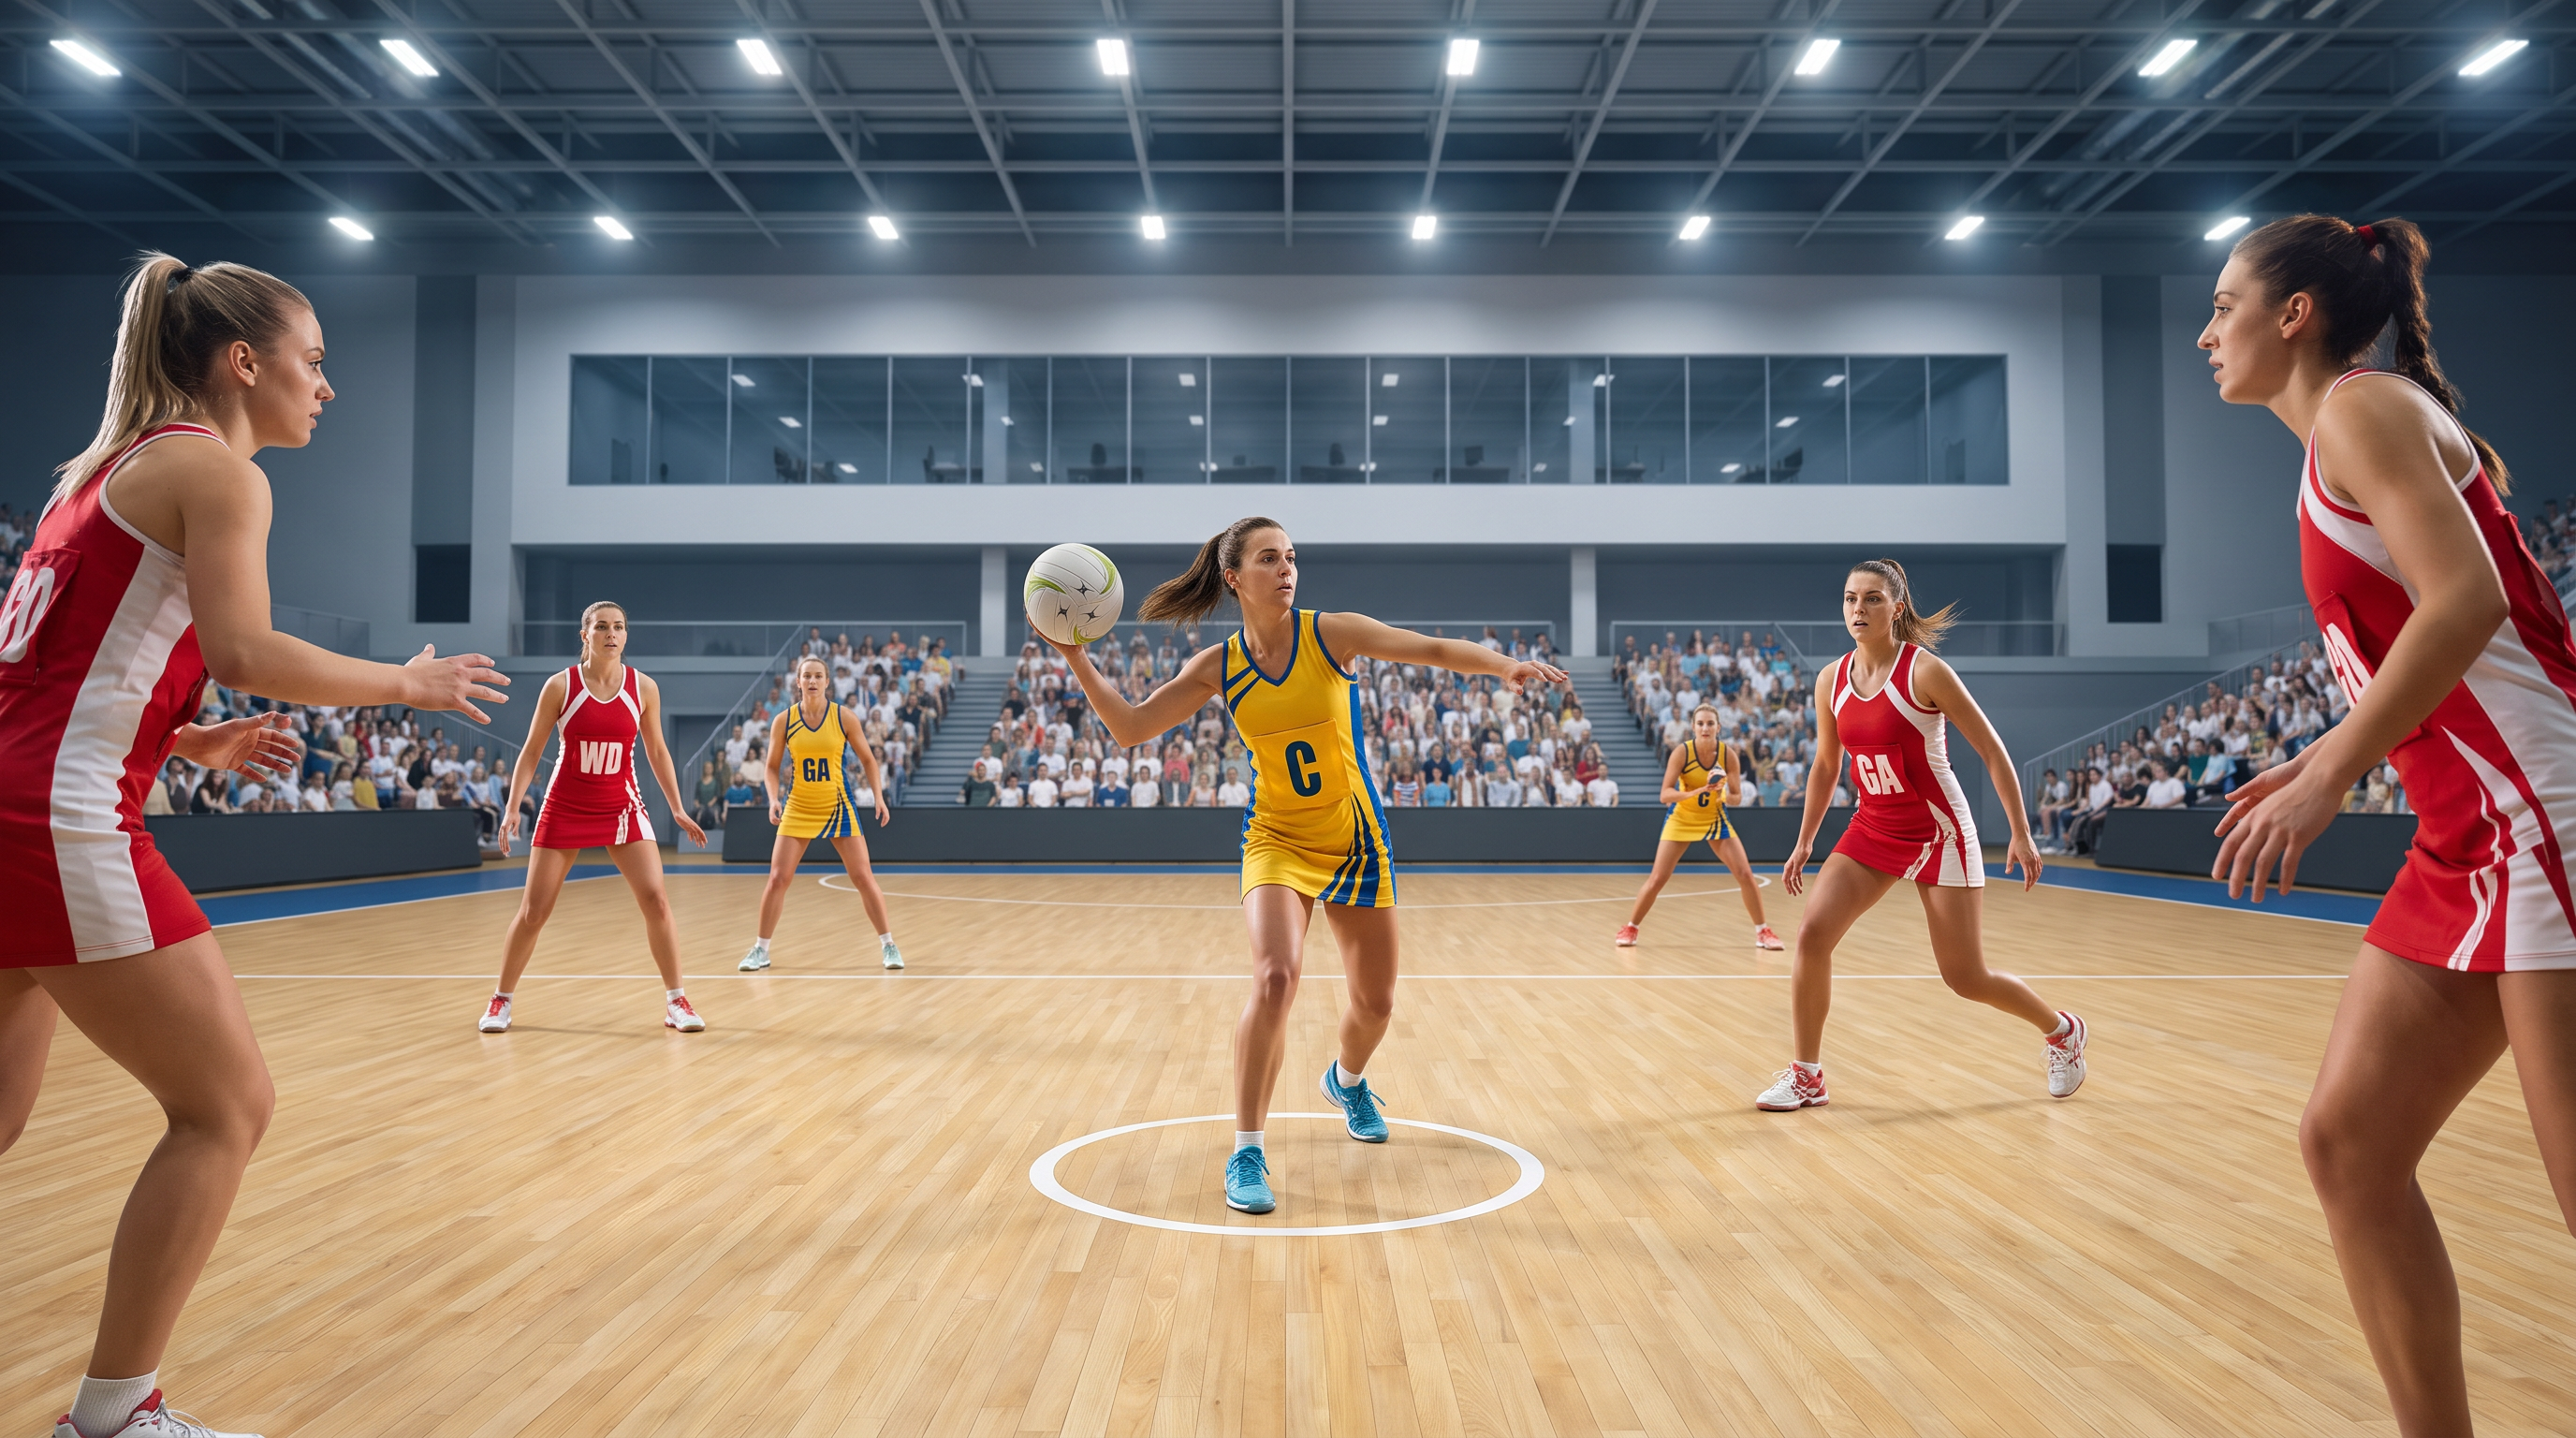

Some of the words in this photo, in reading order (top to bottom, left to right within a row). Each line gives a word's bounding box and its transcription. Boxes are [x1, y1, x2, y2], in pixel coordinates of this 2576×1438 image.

[579, 741, 623, 775] WD
[802, 757, 831, 783] GA
[1284, 741, 1322, 798] C
[1855, 754, 1905, 796] GA
[1698, 791, 1711, 808] C
